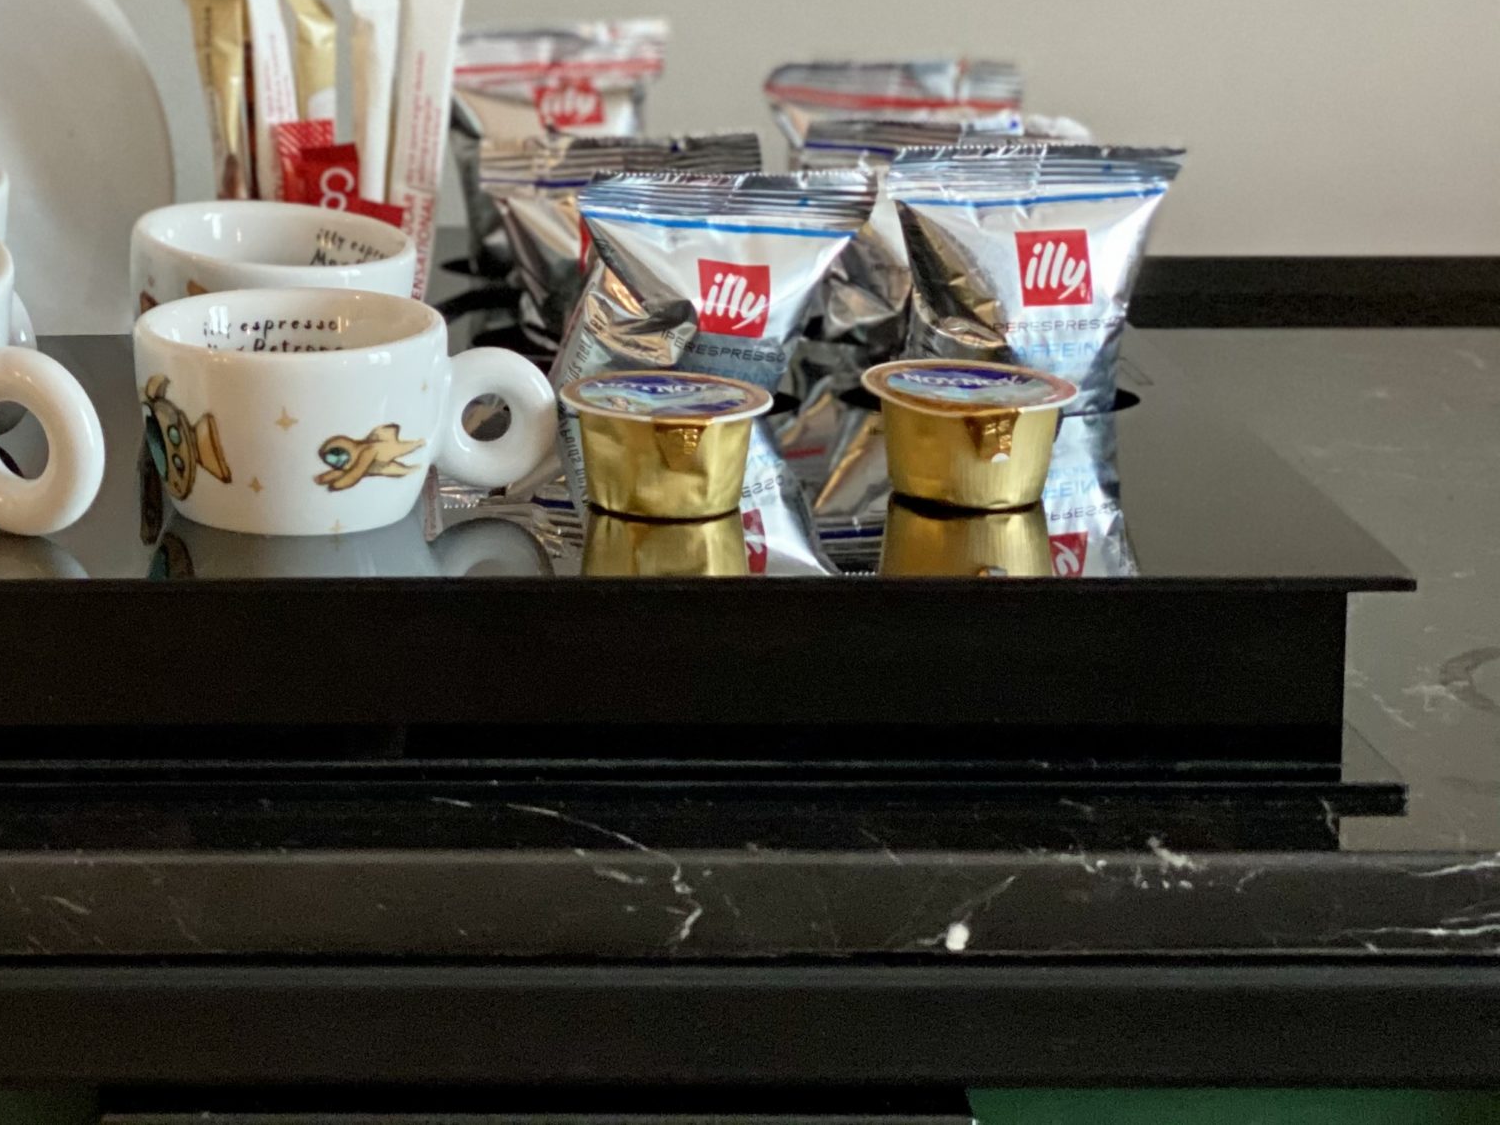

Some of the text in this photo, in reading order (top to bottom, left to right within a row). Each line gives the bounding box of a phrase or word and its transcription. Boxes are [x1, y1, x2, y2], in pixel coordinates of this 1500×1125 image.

[411, 197, 434, 300] ENSATIONAL
[1025, 241, 1087, 299] illy
[240, 318, 339, 340] espresso
[704, 272, 767, 330] illy
[660, 330, 787, 363] IPERESPRESSO
